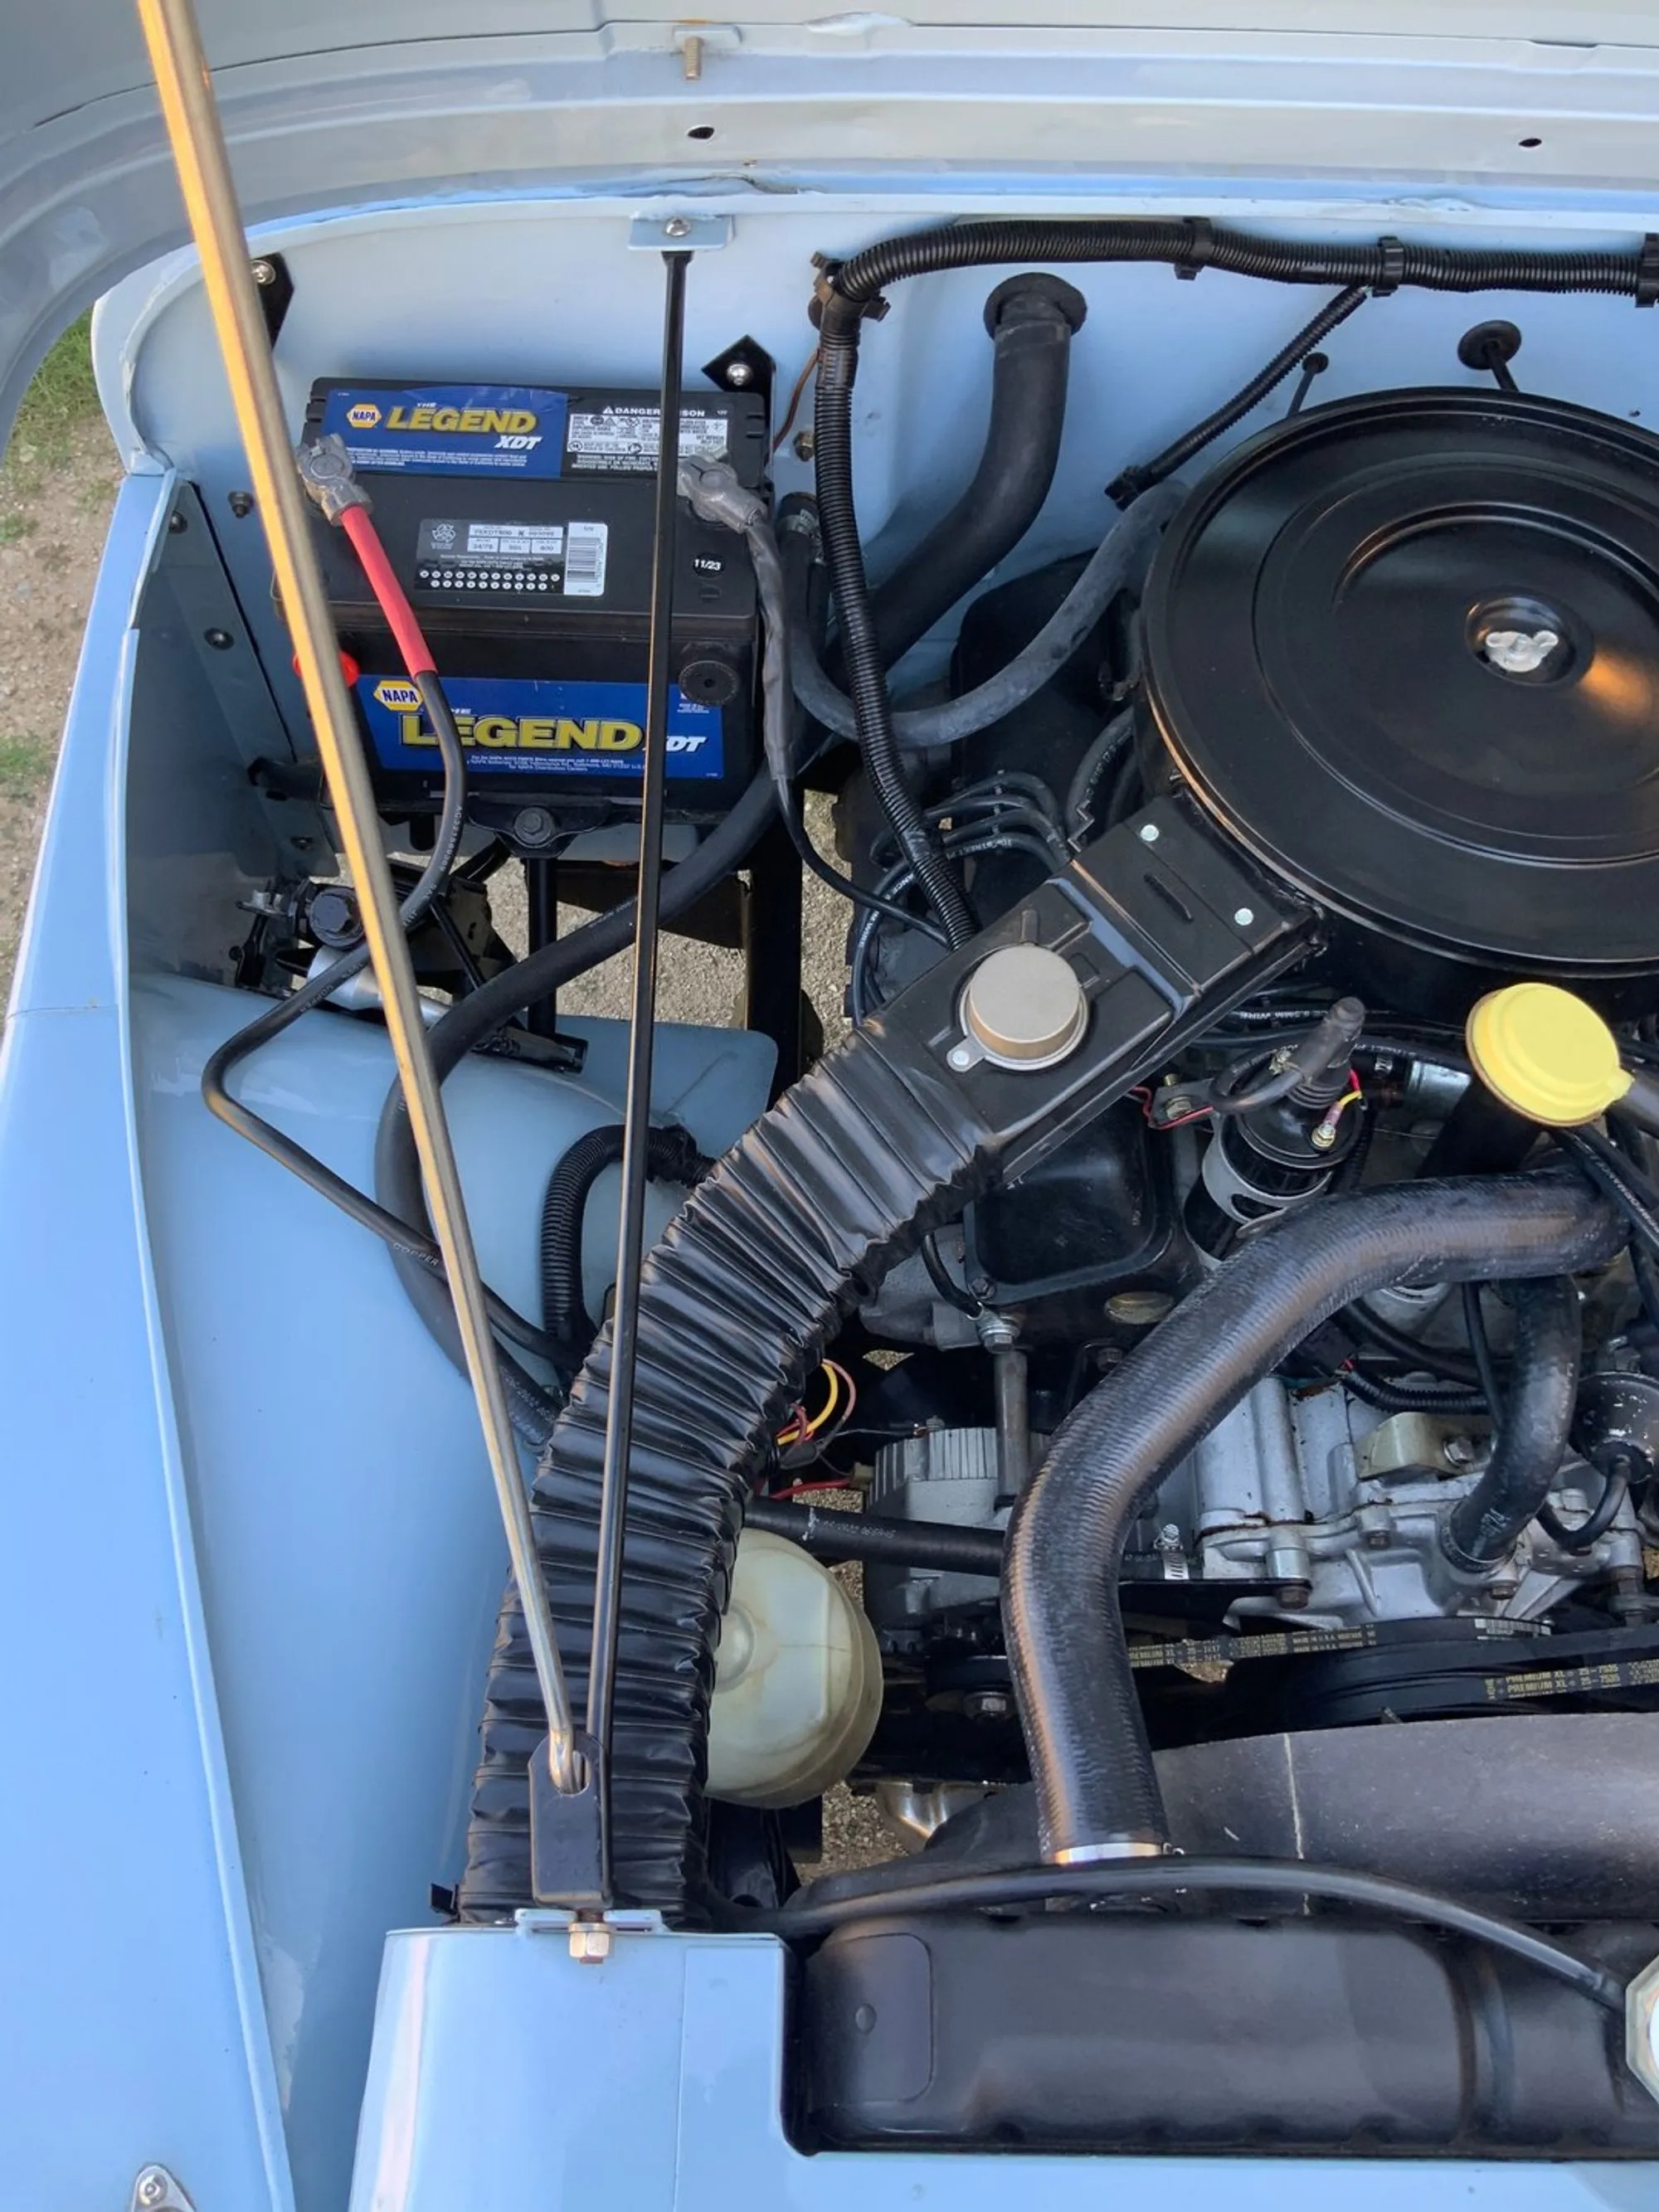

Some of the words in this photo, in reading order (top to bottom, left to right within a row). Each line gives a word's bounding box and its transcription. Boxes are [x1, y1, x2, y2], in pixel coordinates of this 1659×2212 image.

[352, 411, 377, 421] NAPA
[386, 406, 537, 433] LEGEND
[494, 435, 542, 450] XDT
[694, 558, 722, 571] 11/23
[382, 688, 418, 702] NAPA
[401, 715, 643, 750] LEGEND
[643, 736, 707, 752] DT
[1506, 1671, 1551, 1684] PREMIUM
[1554, 1670, 1565, 1679] XL
[1506, 1680, 1553, 1694] PREMIUM
[1555, 1680, 1568, 1689] XL
